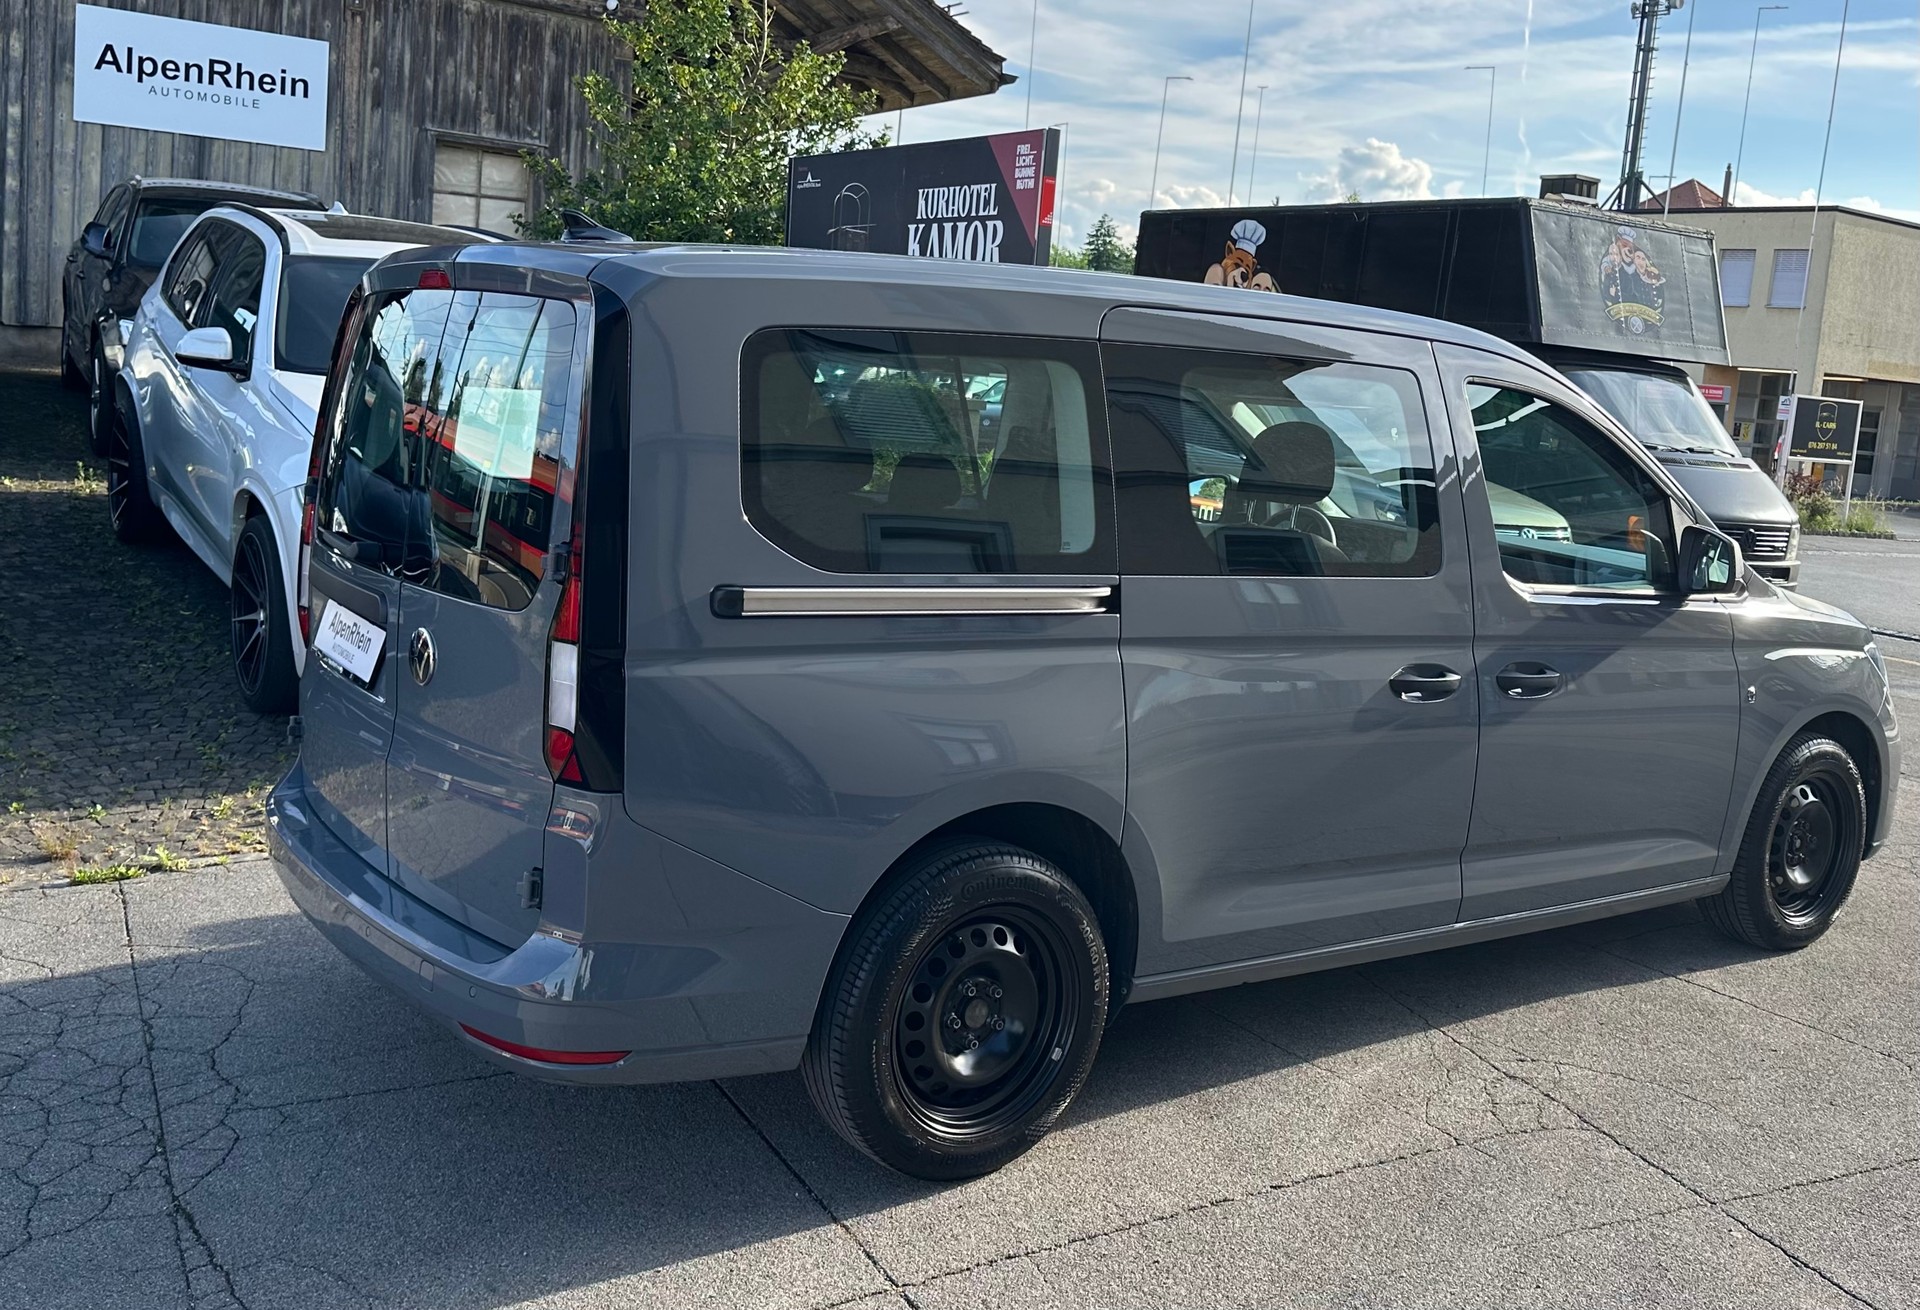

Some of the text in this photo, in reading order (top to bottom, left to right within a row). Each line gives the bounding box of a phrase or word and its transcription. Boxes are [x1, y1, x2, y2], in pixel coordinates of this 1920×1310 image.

[94, 43, 309, 98] AlpenRhein
[148, 85, 260, 109] AUTOMOBILE
[916, 183, 998, 219] KURHOTEL
[907, 219, 1004, 262] KAMOR
[328, 611, 372, 654] AlpenRhein
[961, 874, 1041, 898] Continental
[1078, 919, 1100, 965] 205/60
